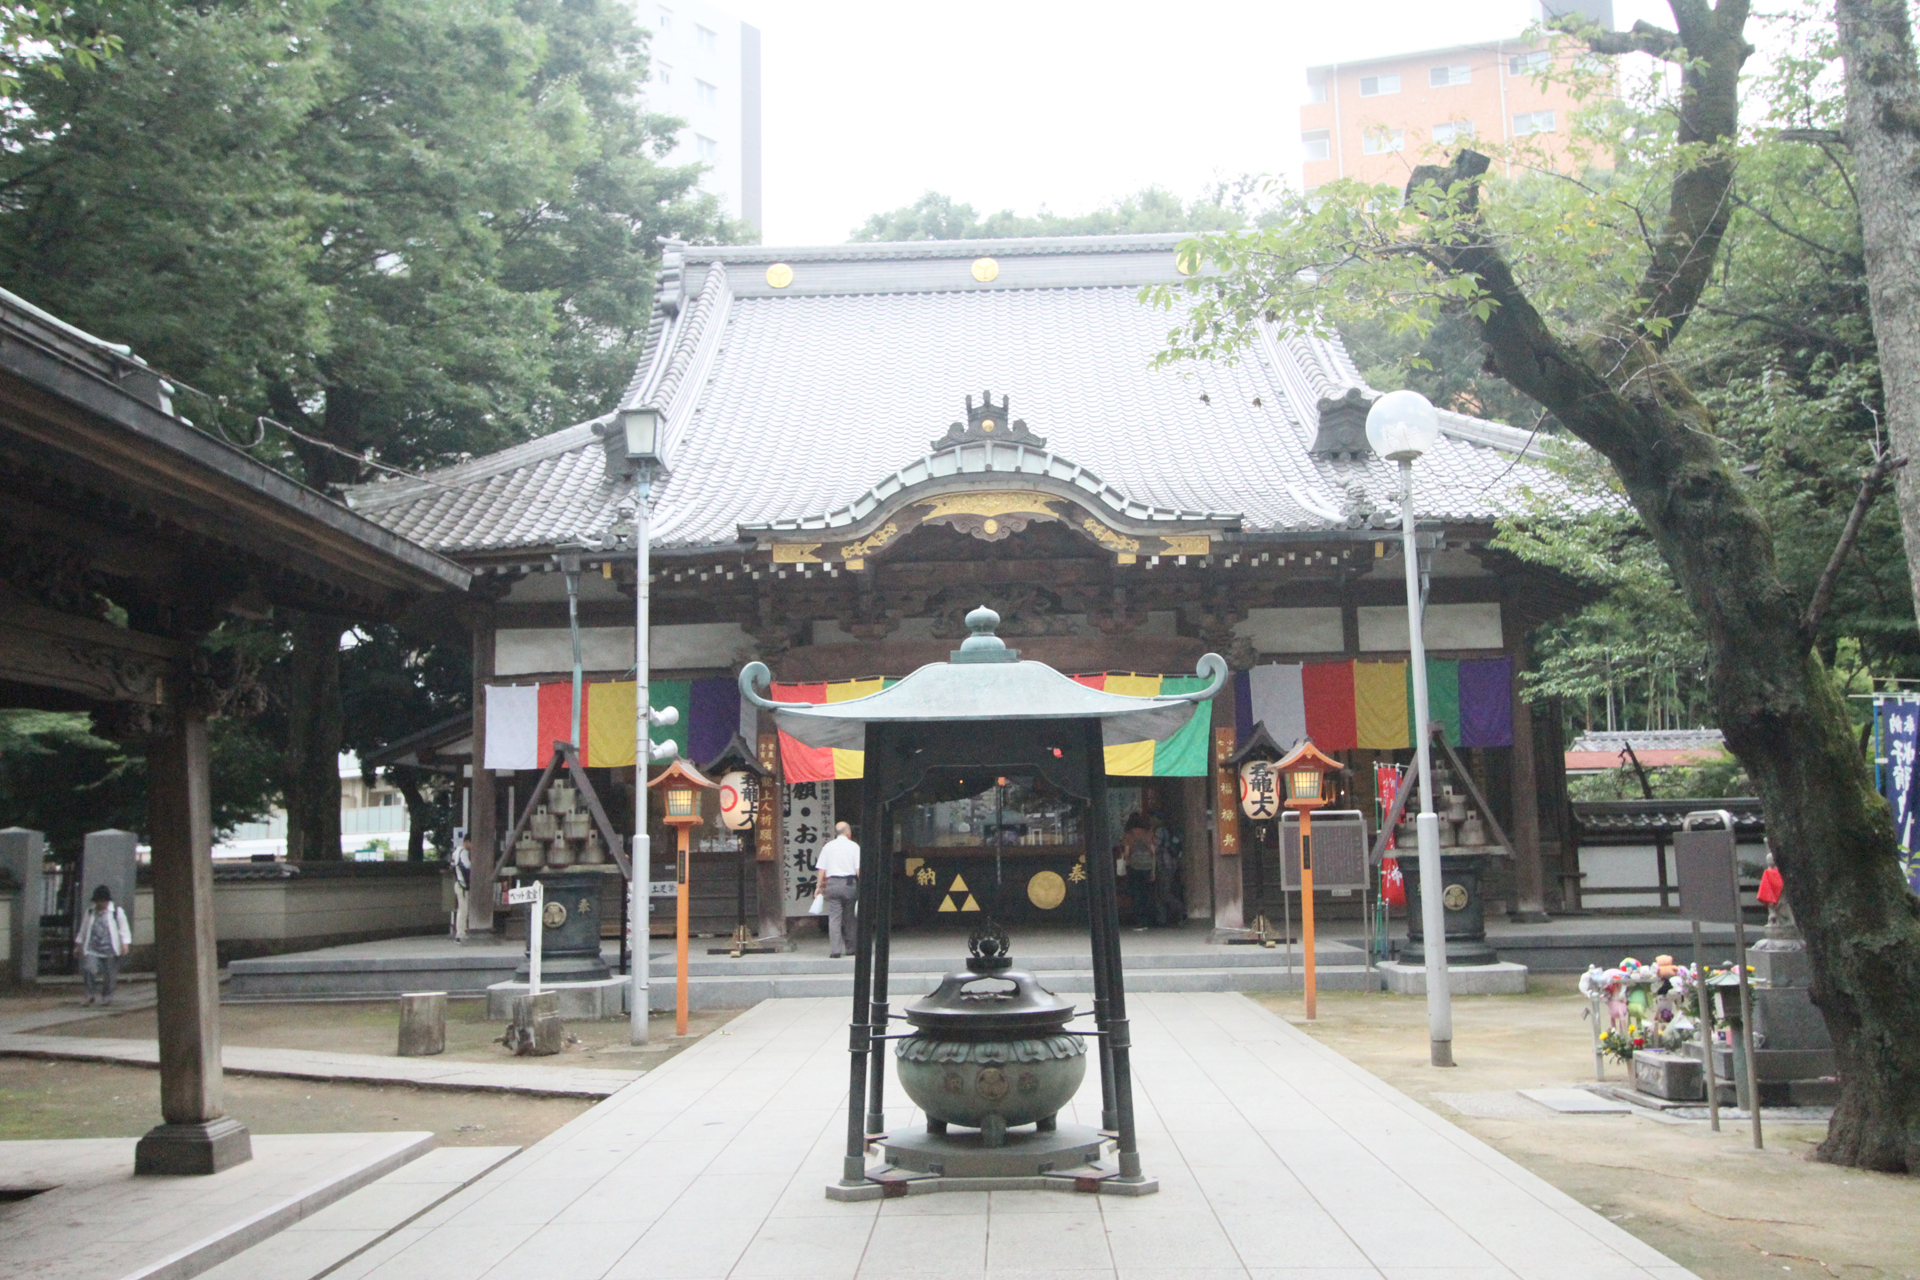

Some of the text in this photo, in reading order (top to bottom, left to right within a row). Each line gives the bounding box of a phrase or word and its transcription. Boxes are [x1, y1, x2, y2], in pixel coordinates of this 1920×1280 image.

[1249, 762, 1275, 818] 呑龍上人
[916, 863, 1087, 886] 奉 納
[651, 883, 678, 894] 土足禁
[577, 898, 591, 915] 奉
